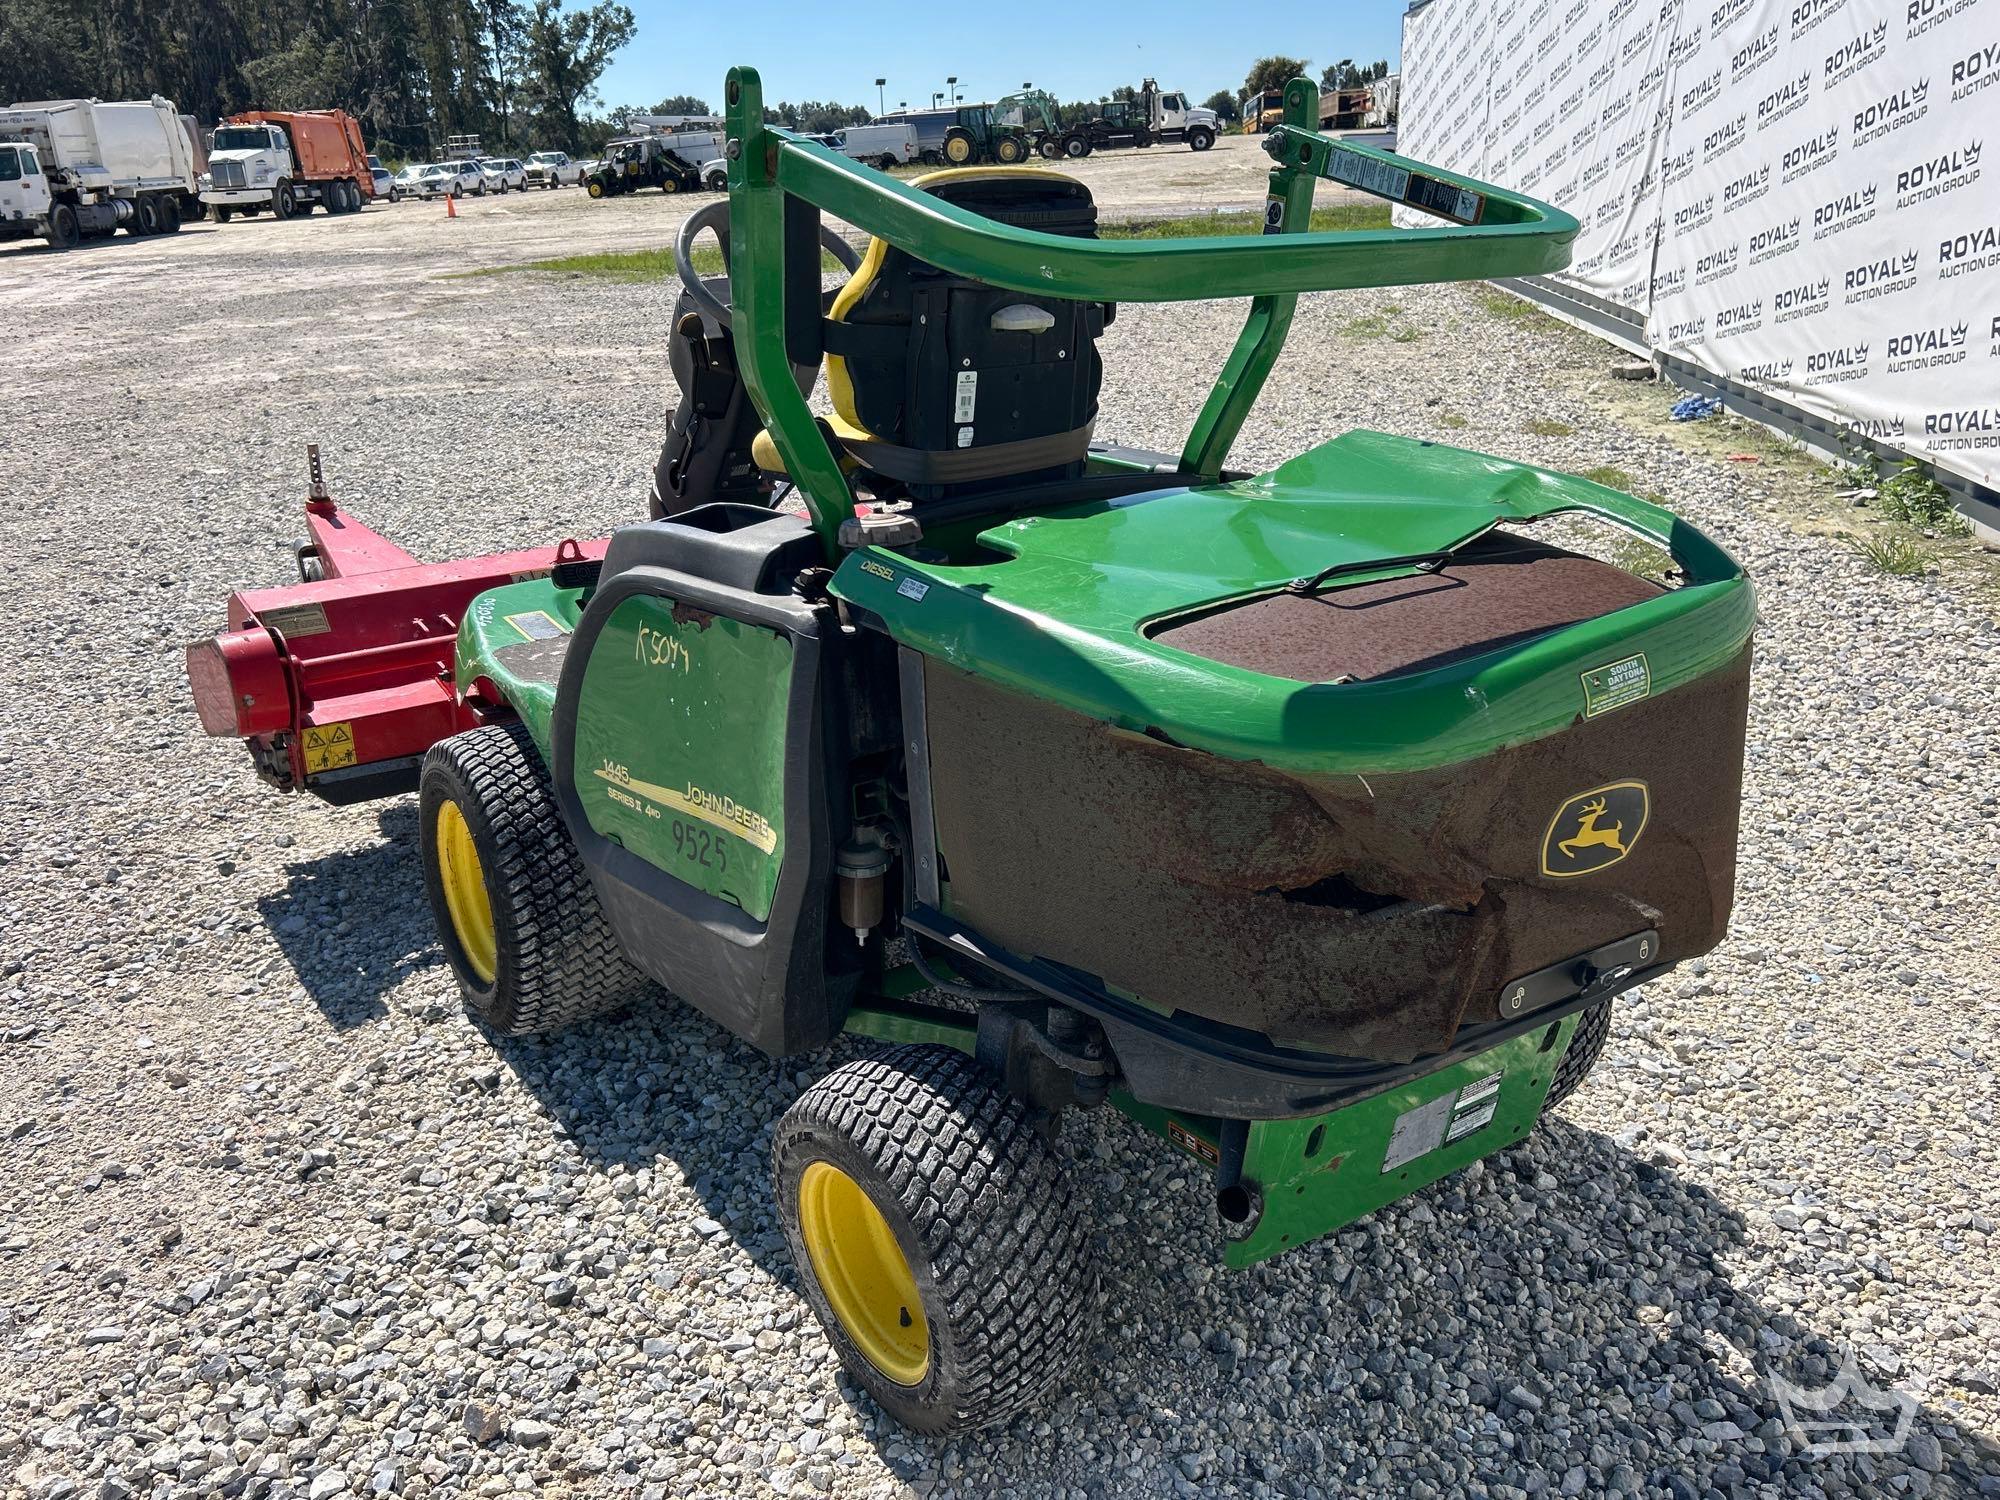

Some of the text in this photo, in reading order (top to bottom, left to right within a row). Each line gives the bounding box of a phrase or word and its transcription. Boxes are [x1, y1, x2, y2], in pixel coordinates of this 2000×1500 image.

[1711, 18, 1734, 40] AUCTION
[1791, 15, 1822, 42] AUCTION
[1906, 7, 1953, 41] AUCTION
[1623, 26, 1646, 57] ROYAL
[1732, 35, 1766, 72] ROYAL
[1825, 32, 1870, 76] ROYAL
[1589, 62, 1608, 88] ROYAL
[1639, 63, 1663, 93] ROYAL
[1731, 46, 1776, 85] AUCTION GROUP
[1824, 45, 1885, 91] AUCTION GROUP
[1682, 76, 1712, 109] ROYAL
[1682, 88, 1720, 120] AUCTION GROUP
[1758, 81, 1796, 118] ROYAL
[1603, 96, 1624, 122] ROYAL
[1757, 94, 1808, 131] AUCTION GROUP
[1854, 90, 1908, 133] ROYAL
[1704, 120, 1736, 152] ROYAL
[1853, 105, 1926, 149] AUCTION GROUP
[1616, 134, 1637, 159] ROYAL
[1703, 133, 1744, 164] AUCTION GROUP
[1783, 136, 1824, 170] ROYAL
[1583, 160, 1603, 182] ROYAL
[1782, 150, 1836, 185] AUCTION GROUP
[1897, 152, 1961, 192] ROYAL
[1724, 171, 1758, 201] ROYAL
[1724, 185, 1768, 213] AUCTION GROUP
[1896, 169, 1979, 209] AUCTION GROUP
[1597, 197, 1618, 219] ROYAL
[1675, 200, 1705, 226] ROYAL
[1814, 192, 1860, 226] ROYAL
[1675, 222, 1694, 237] AUCTION
[1696, 213, 1712, 227] GROUP
[1750, 224, 1787, 252] ROYAL
[1814, 209, 1874, 241] AUCTION GROUP
[1609, 237, 1632, 259] ROYAL
[1696, 248, 1728, 274] ROYAL
[1749, 240, 1798, 266] AUCTION GROUP
[1695, 264, 1736, 285] AUCTION GROUP
[1845, 258, 1899, 289] ROYAL
[1939, 256, 1986, 281] AUCTION
[1775, 284, 1816, 310] ROYAL
[1845, 277, 1916, 304] AUCTION GROUP
[1717, 304, 1750, 326] ROYAL
[1775, 301, 1828, 323] AUCTION GROUP
[1669, 321, 1697, 340] ROYAL
[1715, 320, 1760, 339] AUCTION GROUP
[1888, 328, 1950, 357] ROYAL
[1807, 348, 1852, 372] ROYAL
[1887, 351, 1965, 373] AUCTION GROUP
[1805, 368, 1867, 386] AUCTION GROUP
[1925, 410, 1992, 434] ROYAL
[1925, 437, 1971, 450] AUCTION
[860, 560, 895, 581] DIESEL
[1608, 666, 1646, 686] DAYTONA
[1610, 659, 1639, 676] SOUTH
[603, 758, 630, 783] 1445
[608, 786, 635, 808] SERIES
[682, 781, 769, 838] JOHN DEERE
[672, 819, 727, 873] 9525
